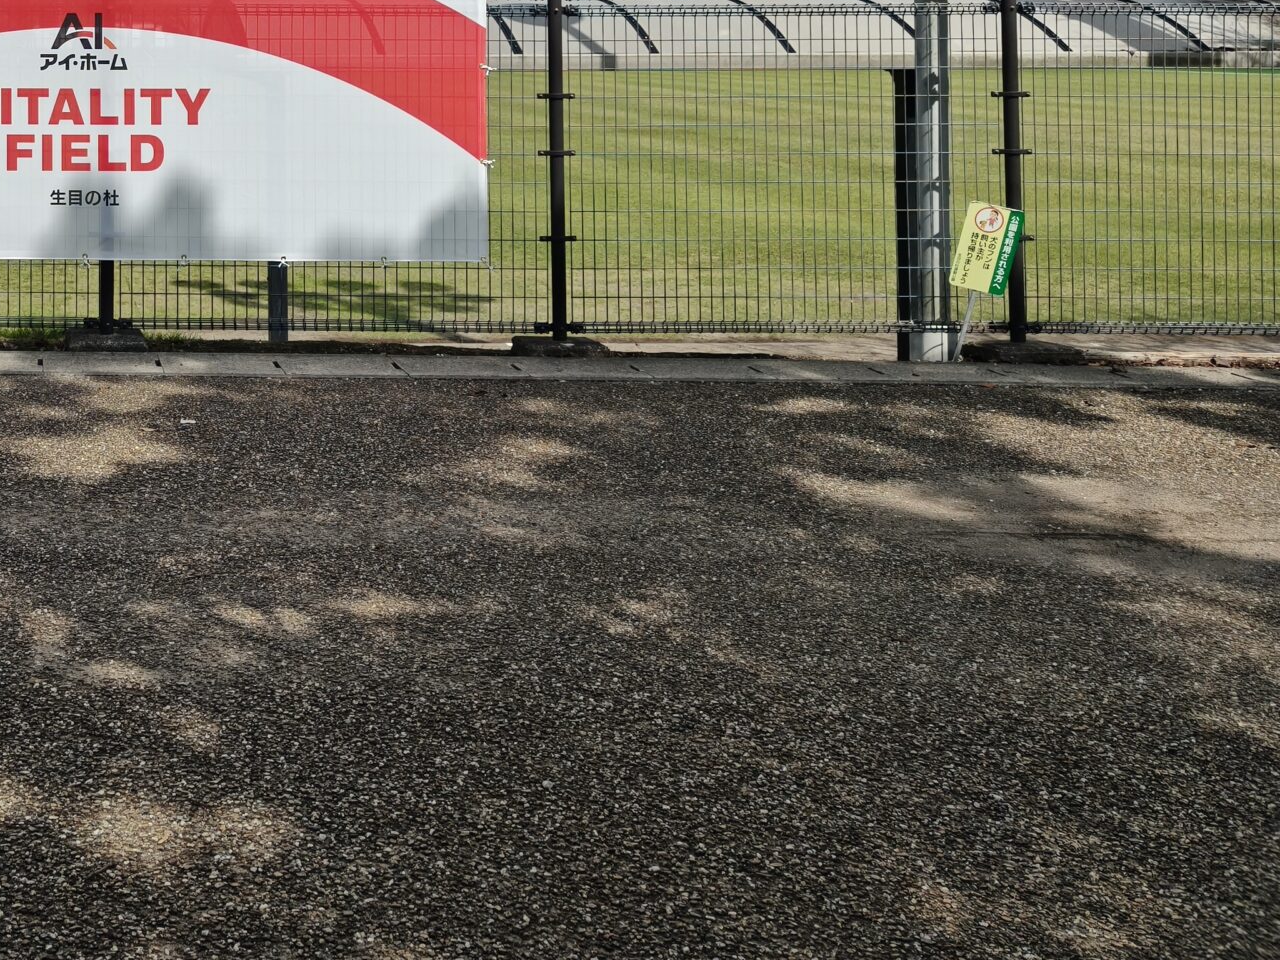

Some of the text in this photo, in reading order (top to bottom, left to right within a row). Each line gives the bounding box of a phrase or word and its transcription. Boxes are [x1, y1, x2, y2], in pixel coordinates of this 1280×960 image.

[40, 53, 128, 71] アイ・ホーム
[6, 134, 165, 172] FIELD
[50, 189, 120, 207] 生目の杜
[960, 232, 979, 284] 持ち帰りましょう
[975, 234, 989, 261] 飼い主が
[982, 236, 998, 270] 犬のフンは
[993, 215, 1020, 290] 公園を利用される方へ
